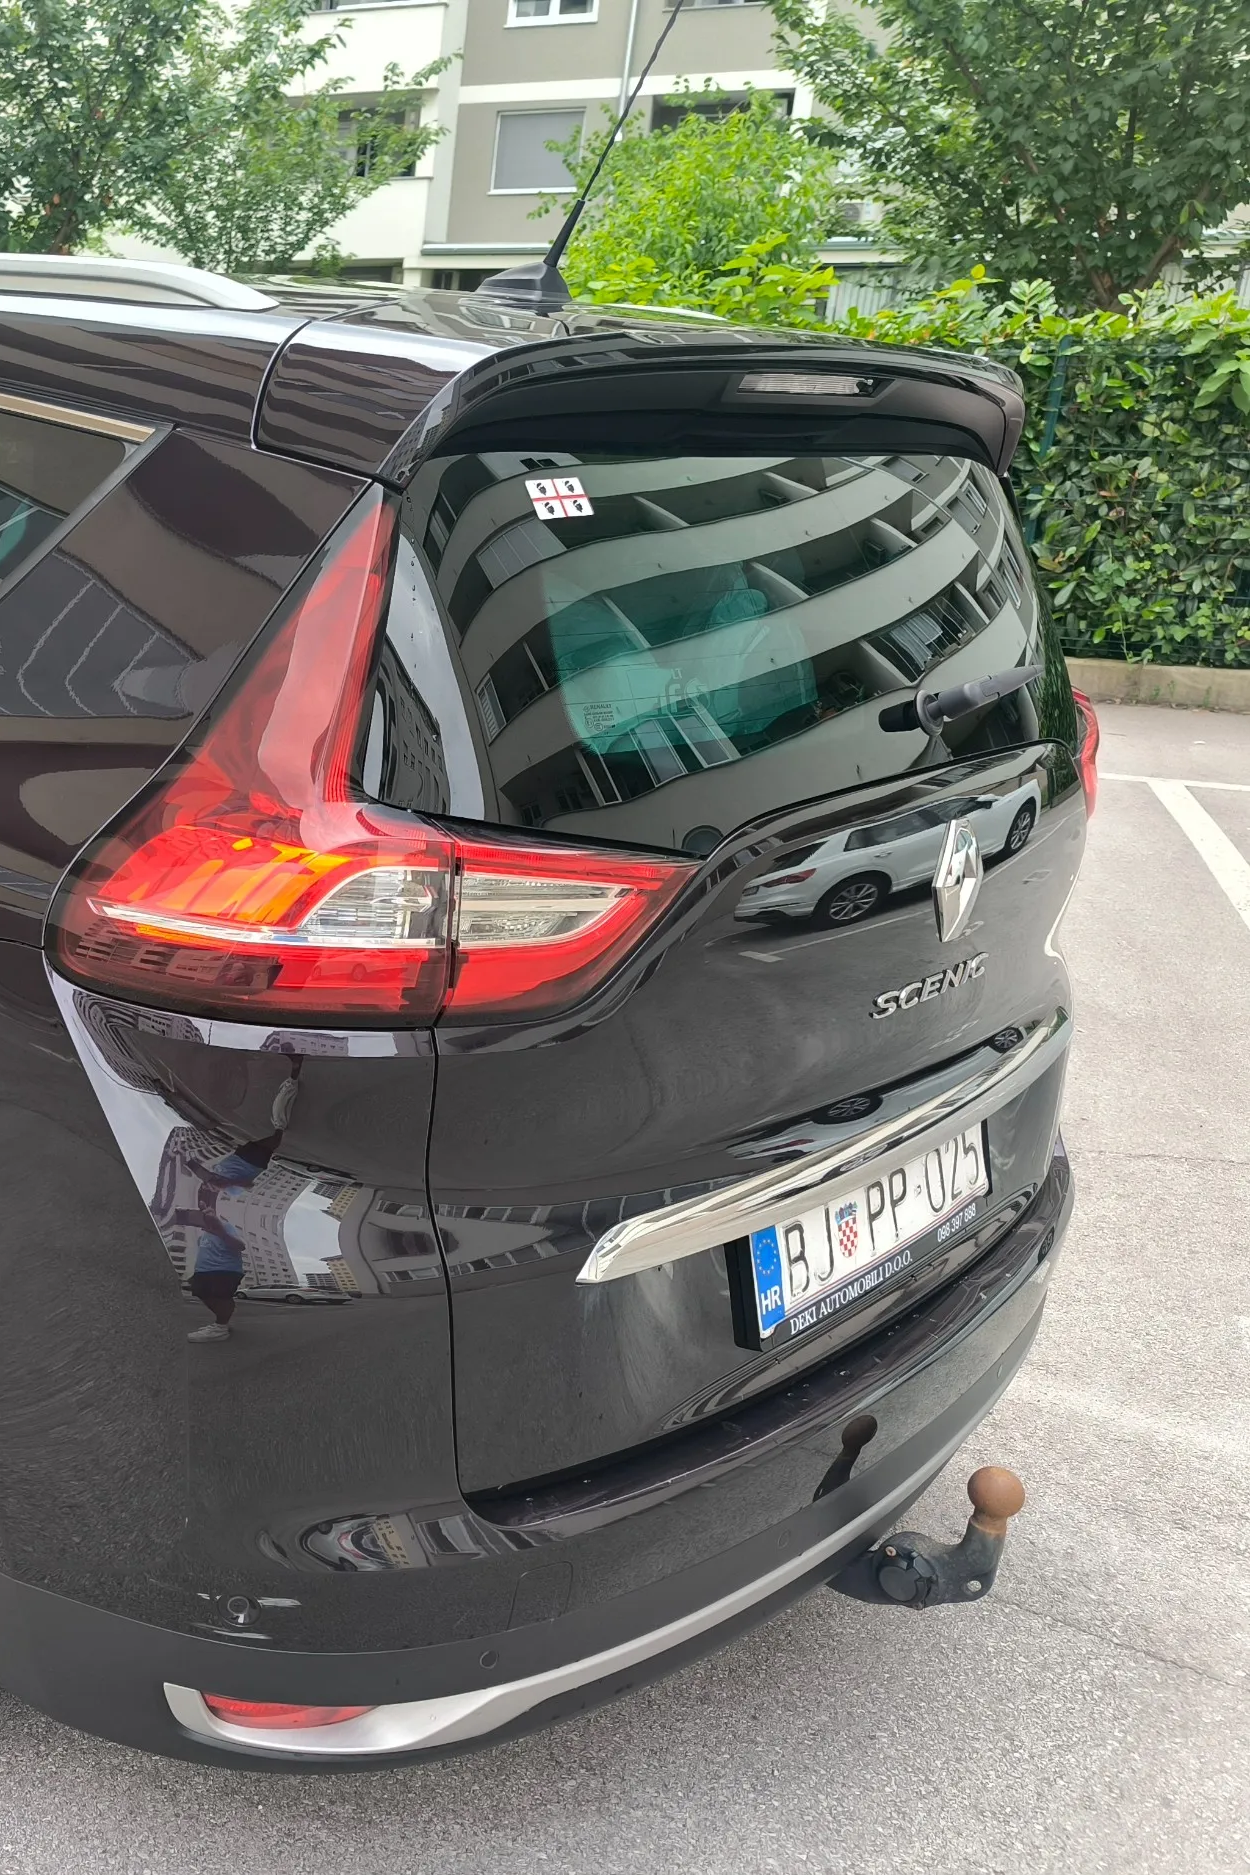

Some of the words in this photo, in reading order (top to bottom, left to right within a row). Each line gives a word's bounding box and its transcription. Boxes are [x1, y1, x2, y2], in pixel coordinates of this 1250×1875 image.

[870, 951, 990, 1020] SCENIC
[784, 1204, 835, 1298] BJ
[937, 1222, 950, 1242] 098
[951, 1212, 963, 1232] 397
[760, 1285, 781, 1315] HR
[790, 1305, 817, 1335] DEKI
[818, 1271, 884, 1318] AUTOMOBILI
[885, 1250, 913, 1278] D.O.O.
